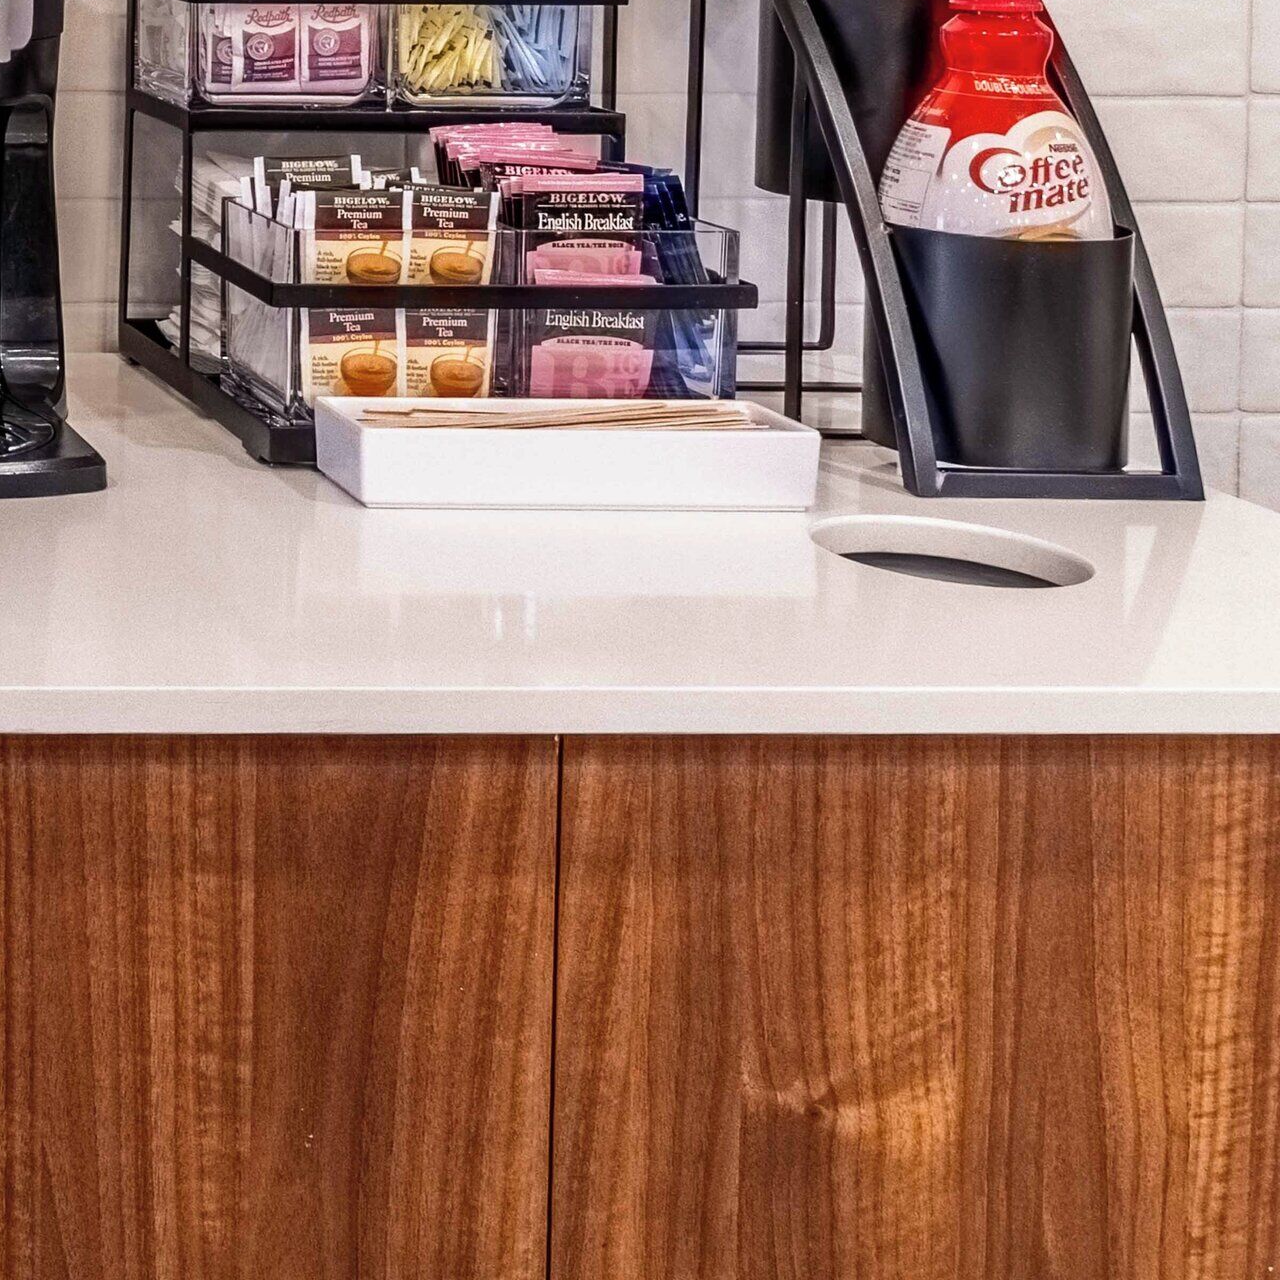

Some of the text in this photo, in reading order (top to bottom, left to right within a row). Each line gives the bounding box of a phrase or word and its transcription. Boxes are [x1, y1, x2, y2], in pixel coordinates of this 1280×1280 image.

[244, 6, 294, 28] Redpath
[968, 147, 1084, 195] Coffee
[285, 172, 332, 183] Premium
[1009, 177, 1090, 214] mate
[336, 208, 383, 219] Premium
[422, 206, 469, 219] Premium
[350, 219, 368, 229] Tea
[436, 218, 454, 228] Tea
[538, 212, 634, 235] English Breakfast
[329, 311, 375, 323] Premium
[422, 316, 468, 327] Premium
[545, 309, 645, 330] English Breakfast
[343, 322, 361, 332] Tea
[436, 327, 454, 337] Tea
